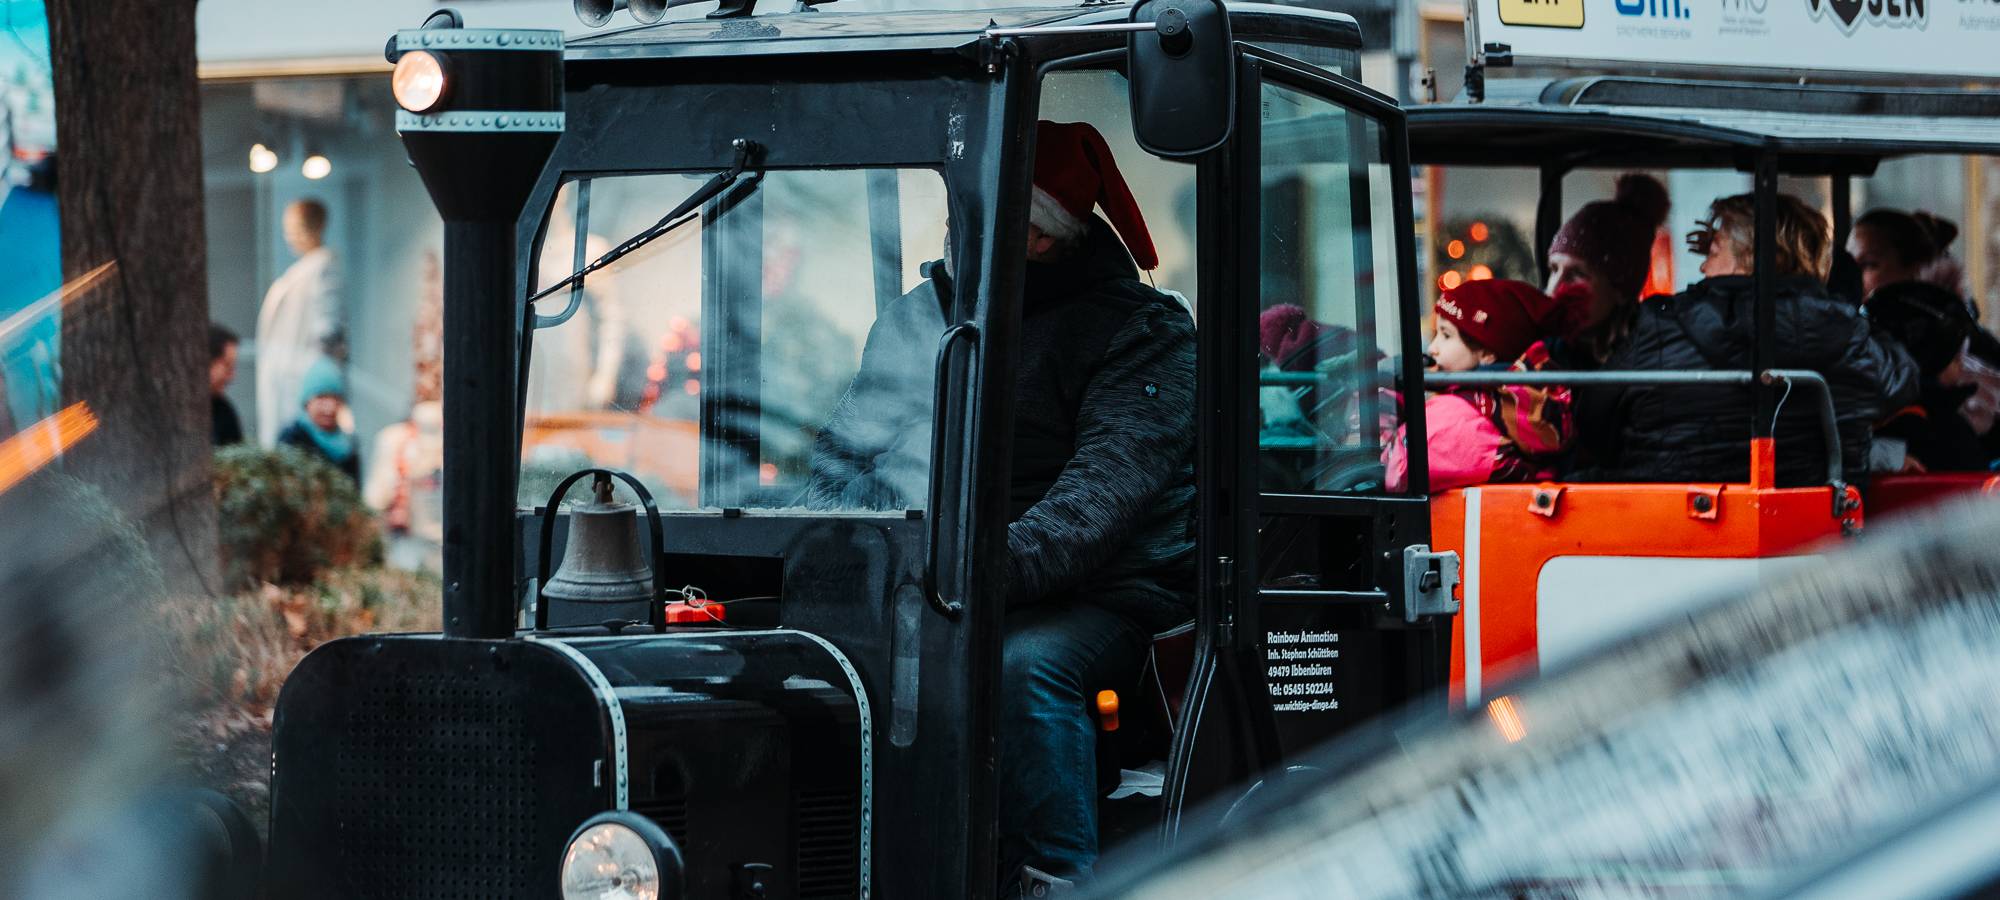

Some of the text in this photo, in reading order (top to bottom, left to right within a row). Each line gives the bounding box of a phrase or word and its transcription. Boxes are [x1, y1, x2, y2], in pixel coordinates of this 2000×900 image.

[1267, 630, 1338, 644] Rainbow Animation
[1267, 649, 1280, 660] Inh.
[1281, 649, 1306, 661] Stephan
[1268, 663, 1332, 677] 49479 Ibbenbüren
[1268, 682, 1333, 696] Tel: 05451 502244
